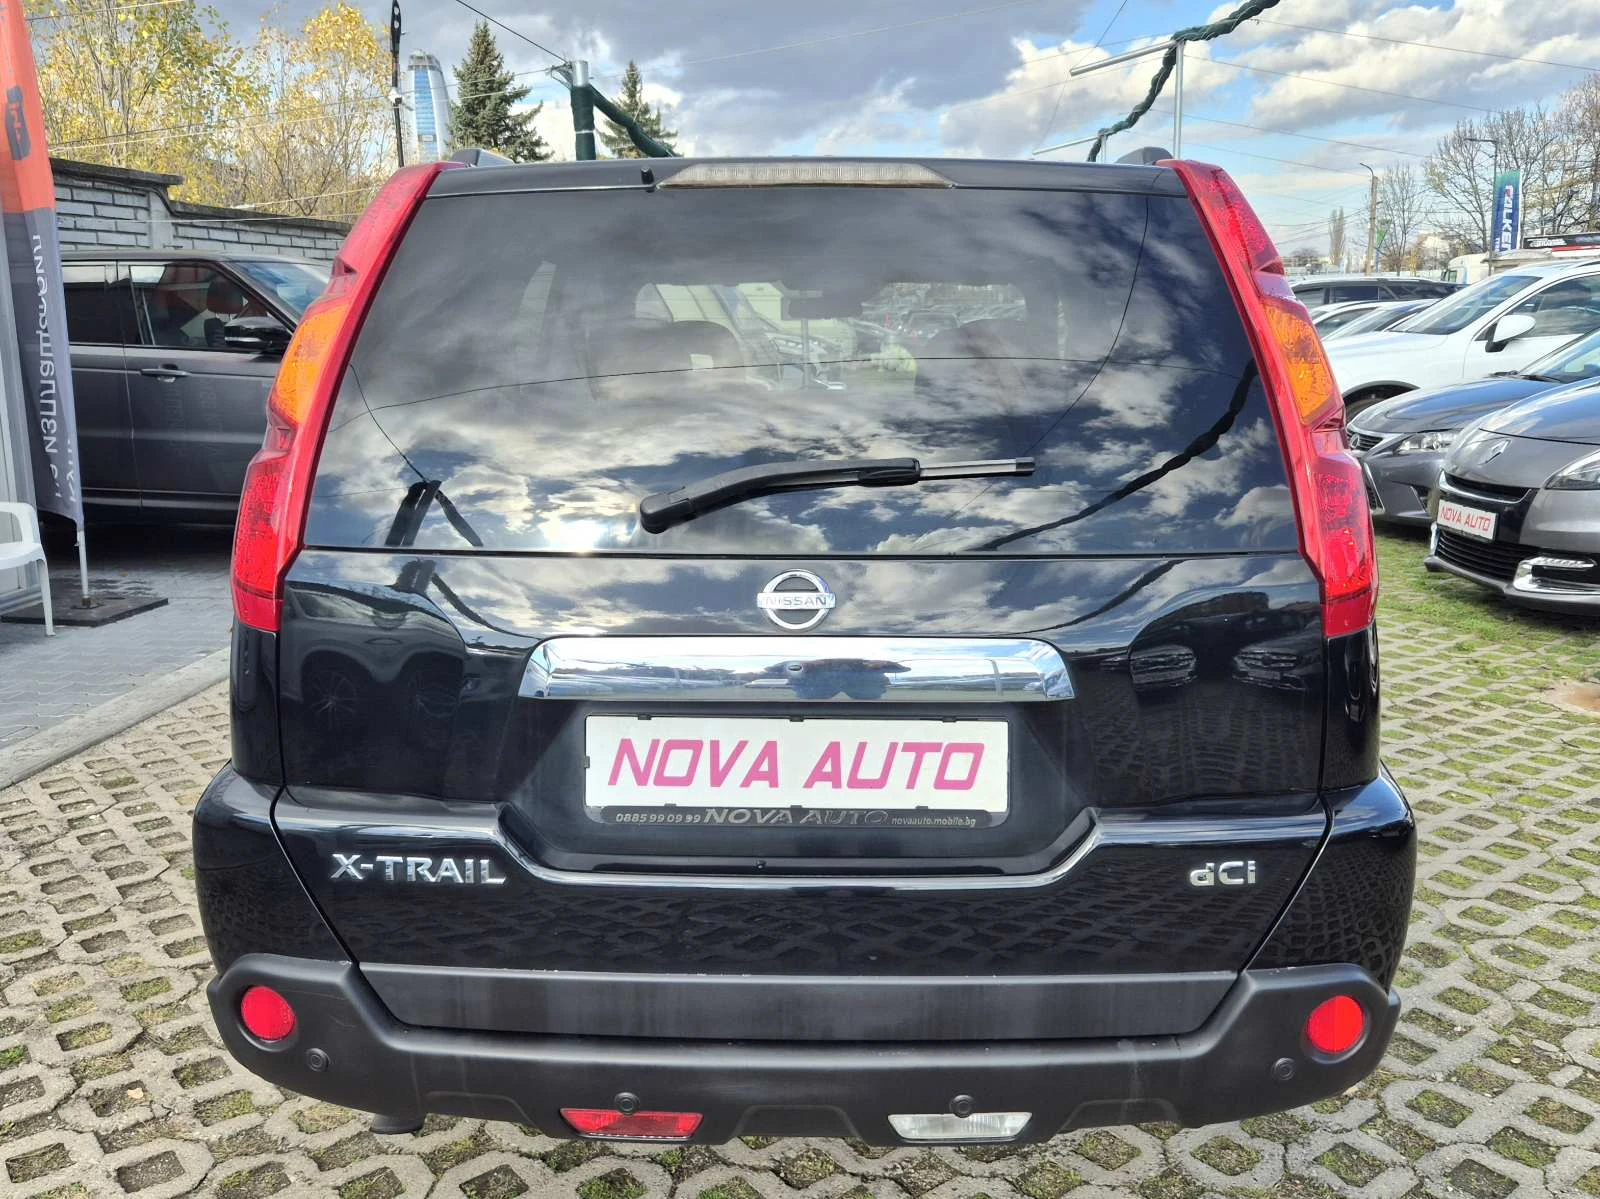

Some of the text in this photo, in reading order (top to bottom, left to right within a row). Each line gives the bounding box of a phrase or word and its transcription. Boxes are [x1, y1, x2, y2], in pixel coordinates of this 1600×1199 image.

[1441, 505, 1491, 532] NOVA AUTO
[765, 596, 827, 606] NISSAN
[607, 738, 986, 790] NOVA AUTO
[615, 813, 648, 823] 0885
[649, 814, 665, 823] 99
[666, 814, 683, 823] 09
[685, 814, 701, 824] 99
[703, 808, 793, 824] NOVA
[799, 809, 889, 825] AUTO
[330, 853, 507, 885] X-TRAIL
[1190, 860, 1257, 887] dCi
